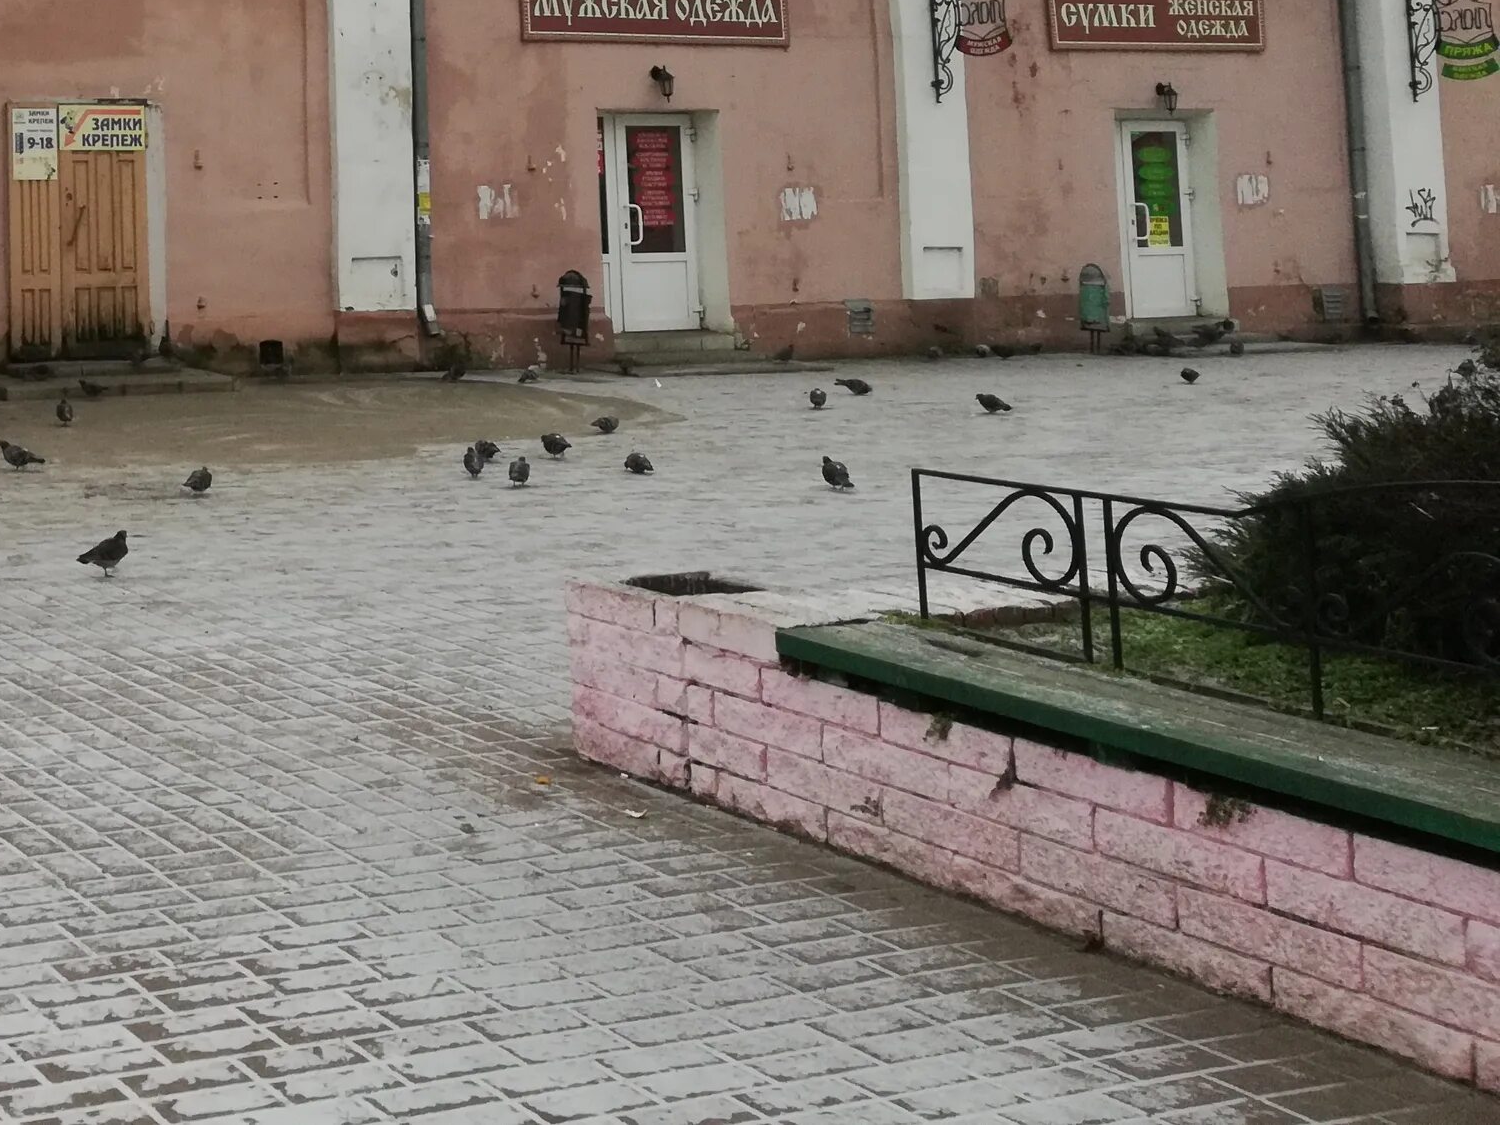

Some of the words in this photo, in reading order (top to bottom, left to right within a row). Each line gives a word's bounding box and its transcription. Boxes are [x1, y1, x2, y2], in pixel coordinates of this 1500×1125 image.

[1168, 0, 1254, 16] ЖЕНСКАЯ
[1061, 2, 1156, 34] СУМКИ
[1176, 19, 1249, 39] ОДЕЖДА
[1444, 42, 1494, 56] ПРЯЖА
[91, 117, 143, 132] ЗАМКИ
[27, 136, 55, 150] 9-18
[81, 133, 143, 149] КРЕПЕЖ
